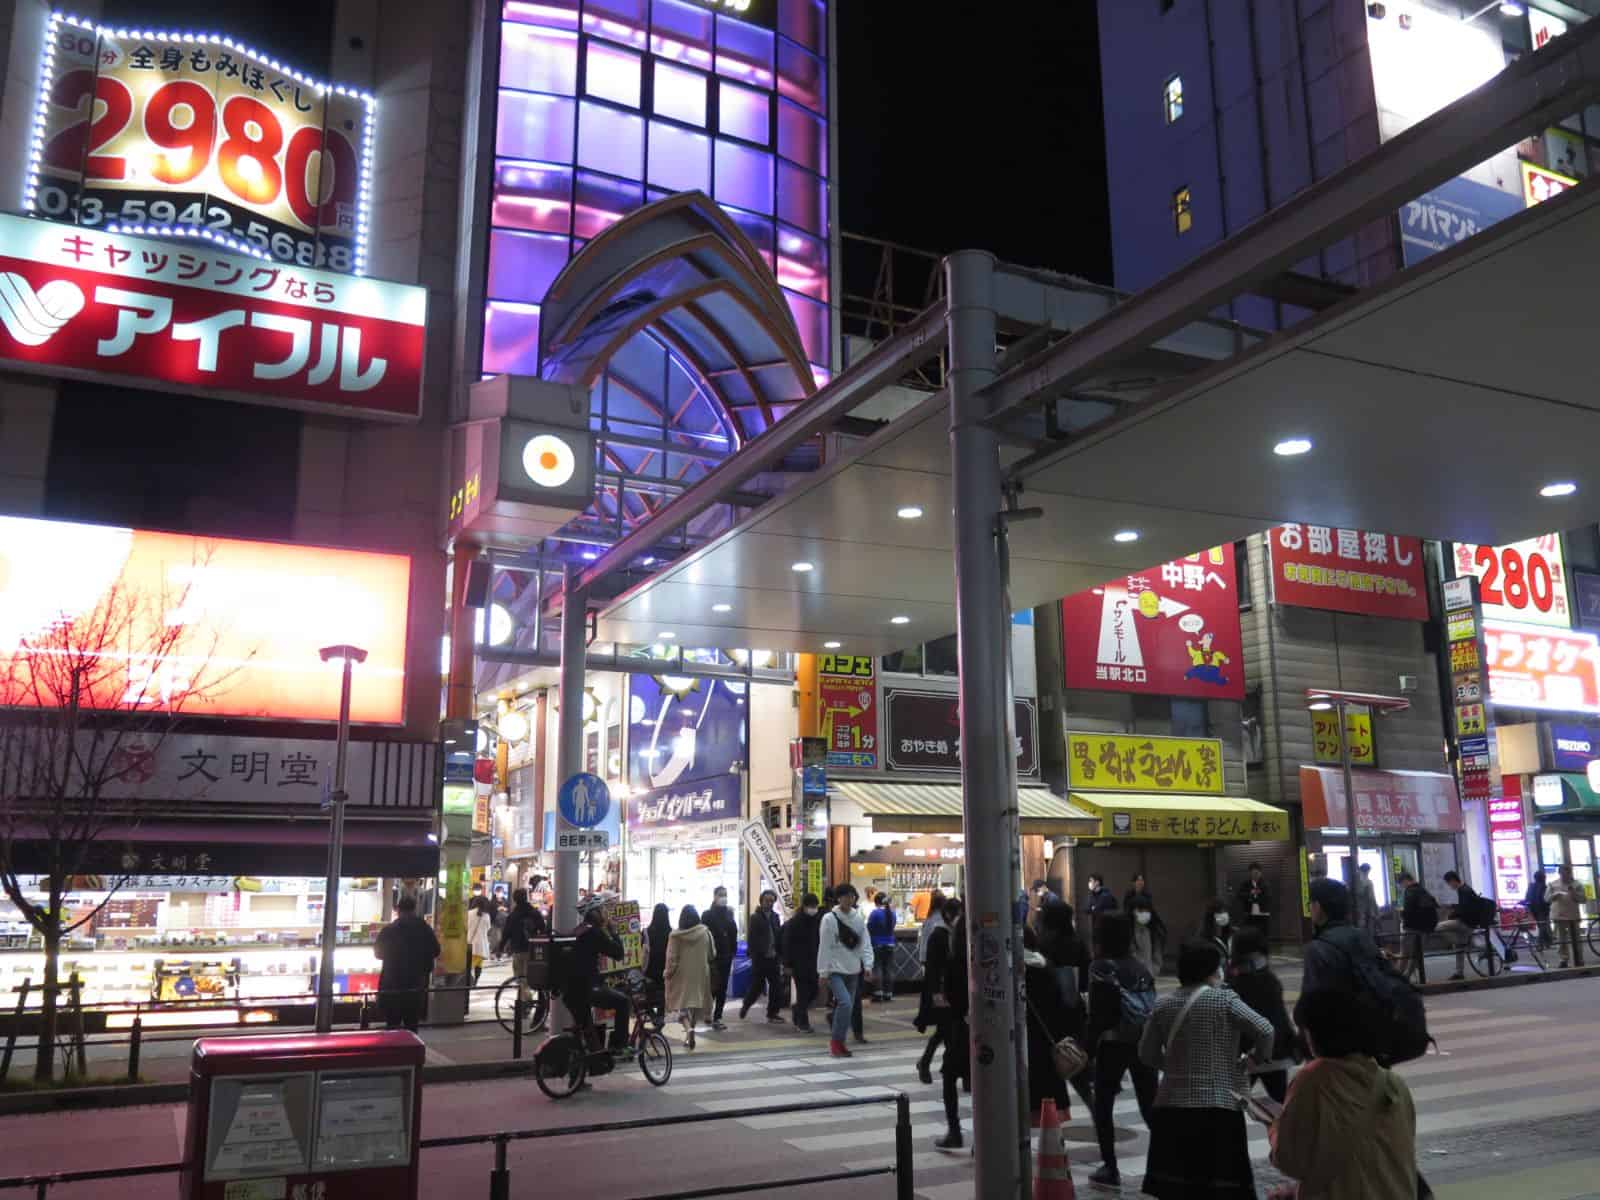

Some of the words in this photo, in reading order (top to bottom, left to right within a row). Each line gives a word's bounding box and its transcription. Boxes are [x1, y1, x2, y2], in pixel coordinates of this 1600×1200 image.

[129, 46, 313, 113] 全身もみほぐし
[37, 69, 359, 232] 2980
[37, 186, 354, 272] 03-5942-5688
[61, 235, 336, 304] キャッシングなら
[94, 285, 388, 392] アイフル
[1161, 561, 1227, 592] 中野へ
[1280, 523, 1413, 566] お部屋探し
[1474, 545, 1553, 613] 280
[177, 748, 319, 787] 文明堂
[1317, 742, 1370, 758] マンョン
